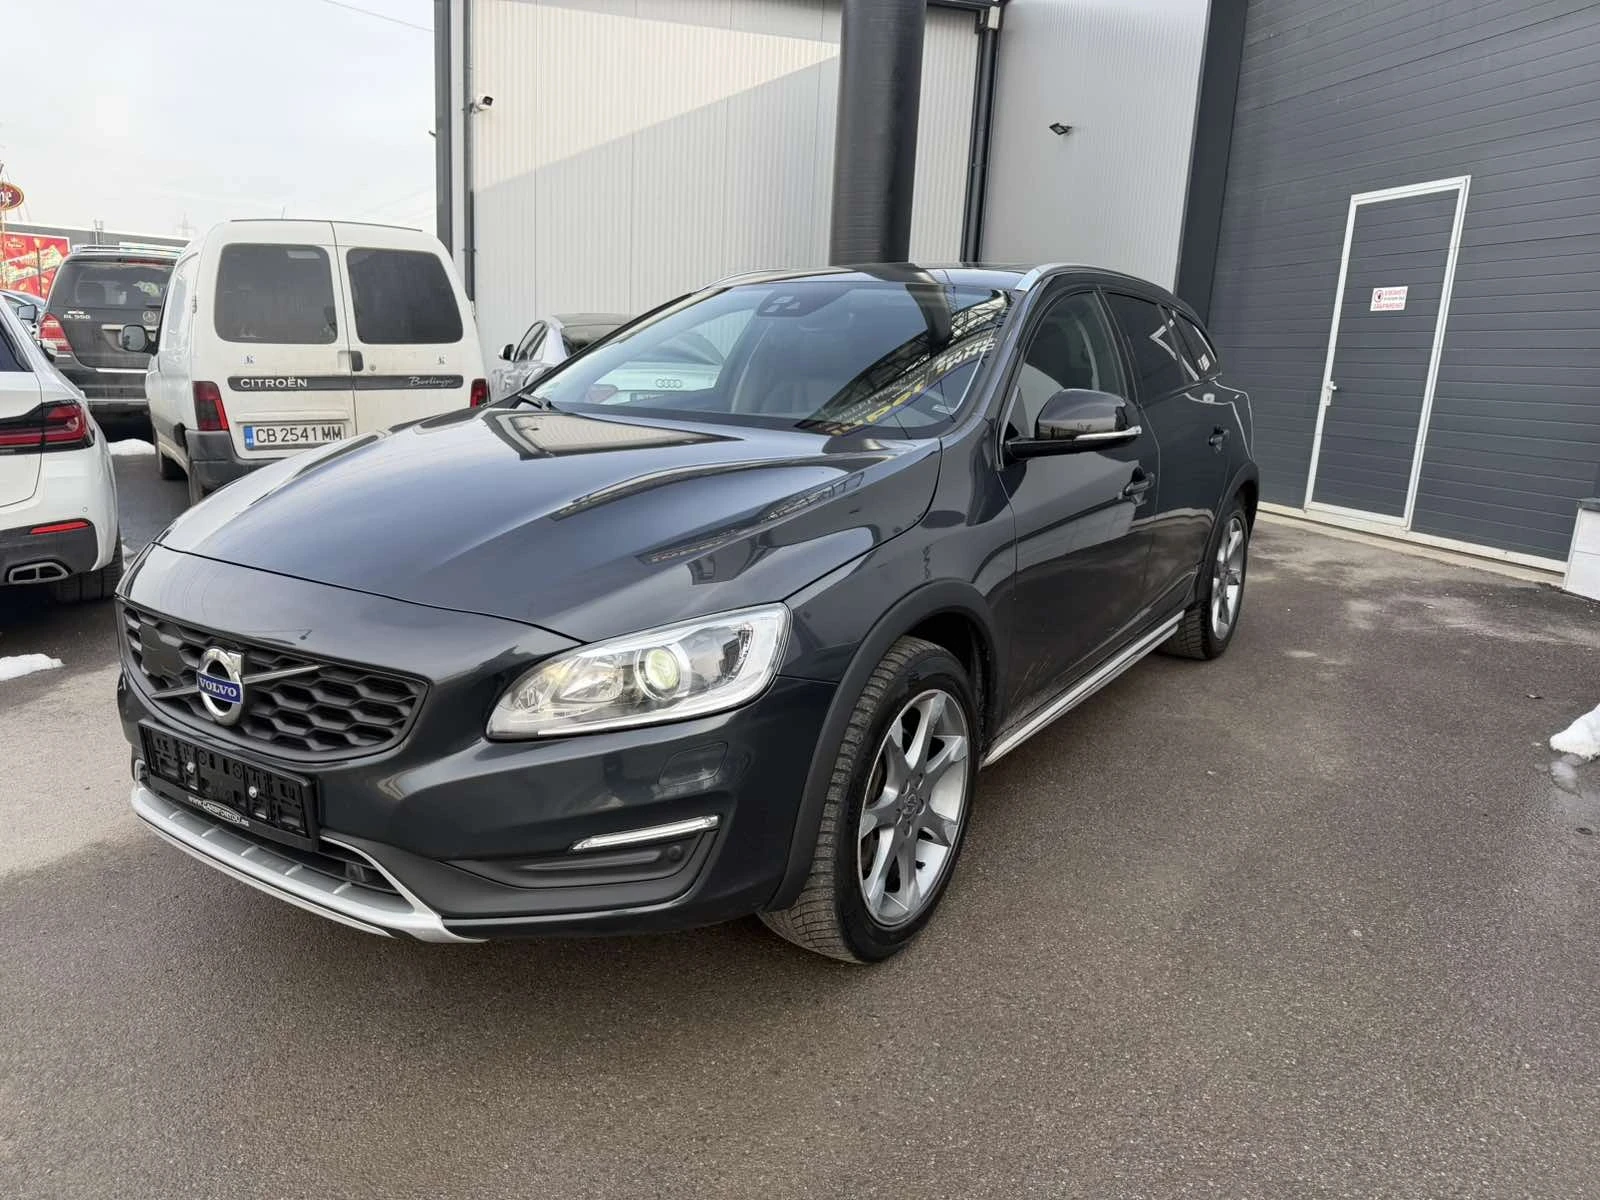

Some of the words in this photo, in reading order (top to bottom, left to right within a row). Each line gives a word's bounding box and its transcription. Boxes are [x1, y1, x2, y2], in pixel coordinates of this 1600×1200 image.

[240, 377, 308, 388] CITROËN
[255, 428, 278, 443] CB
[280, 426, 318, 443] 2541
[321, 425, 343, 441] MM
[199, 677, 237, 698] VOLVO
